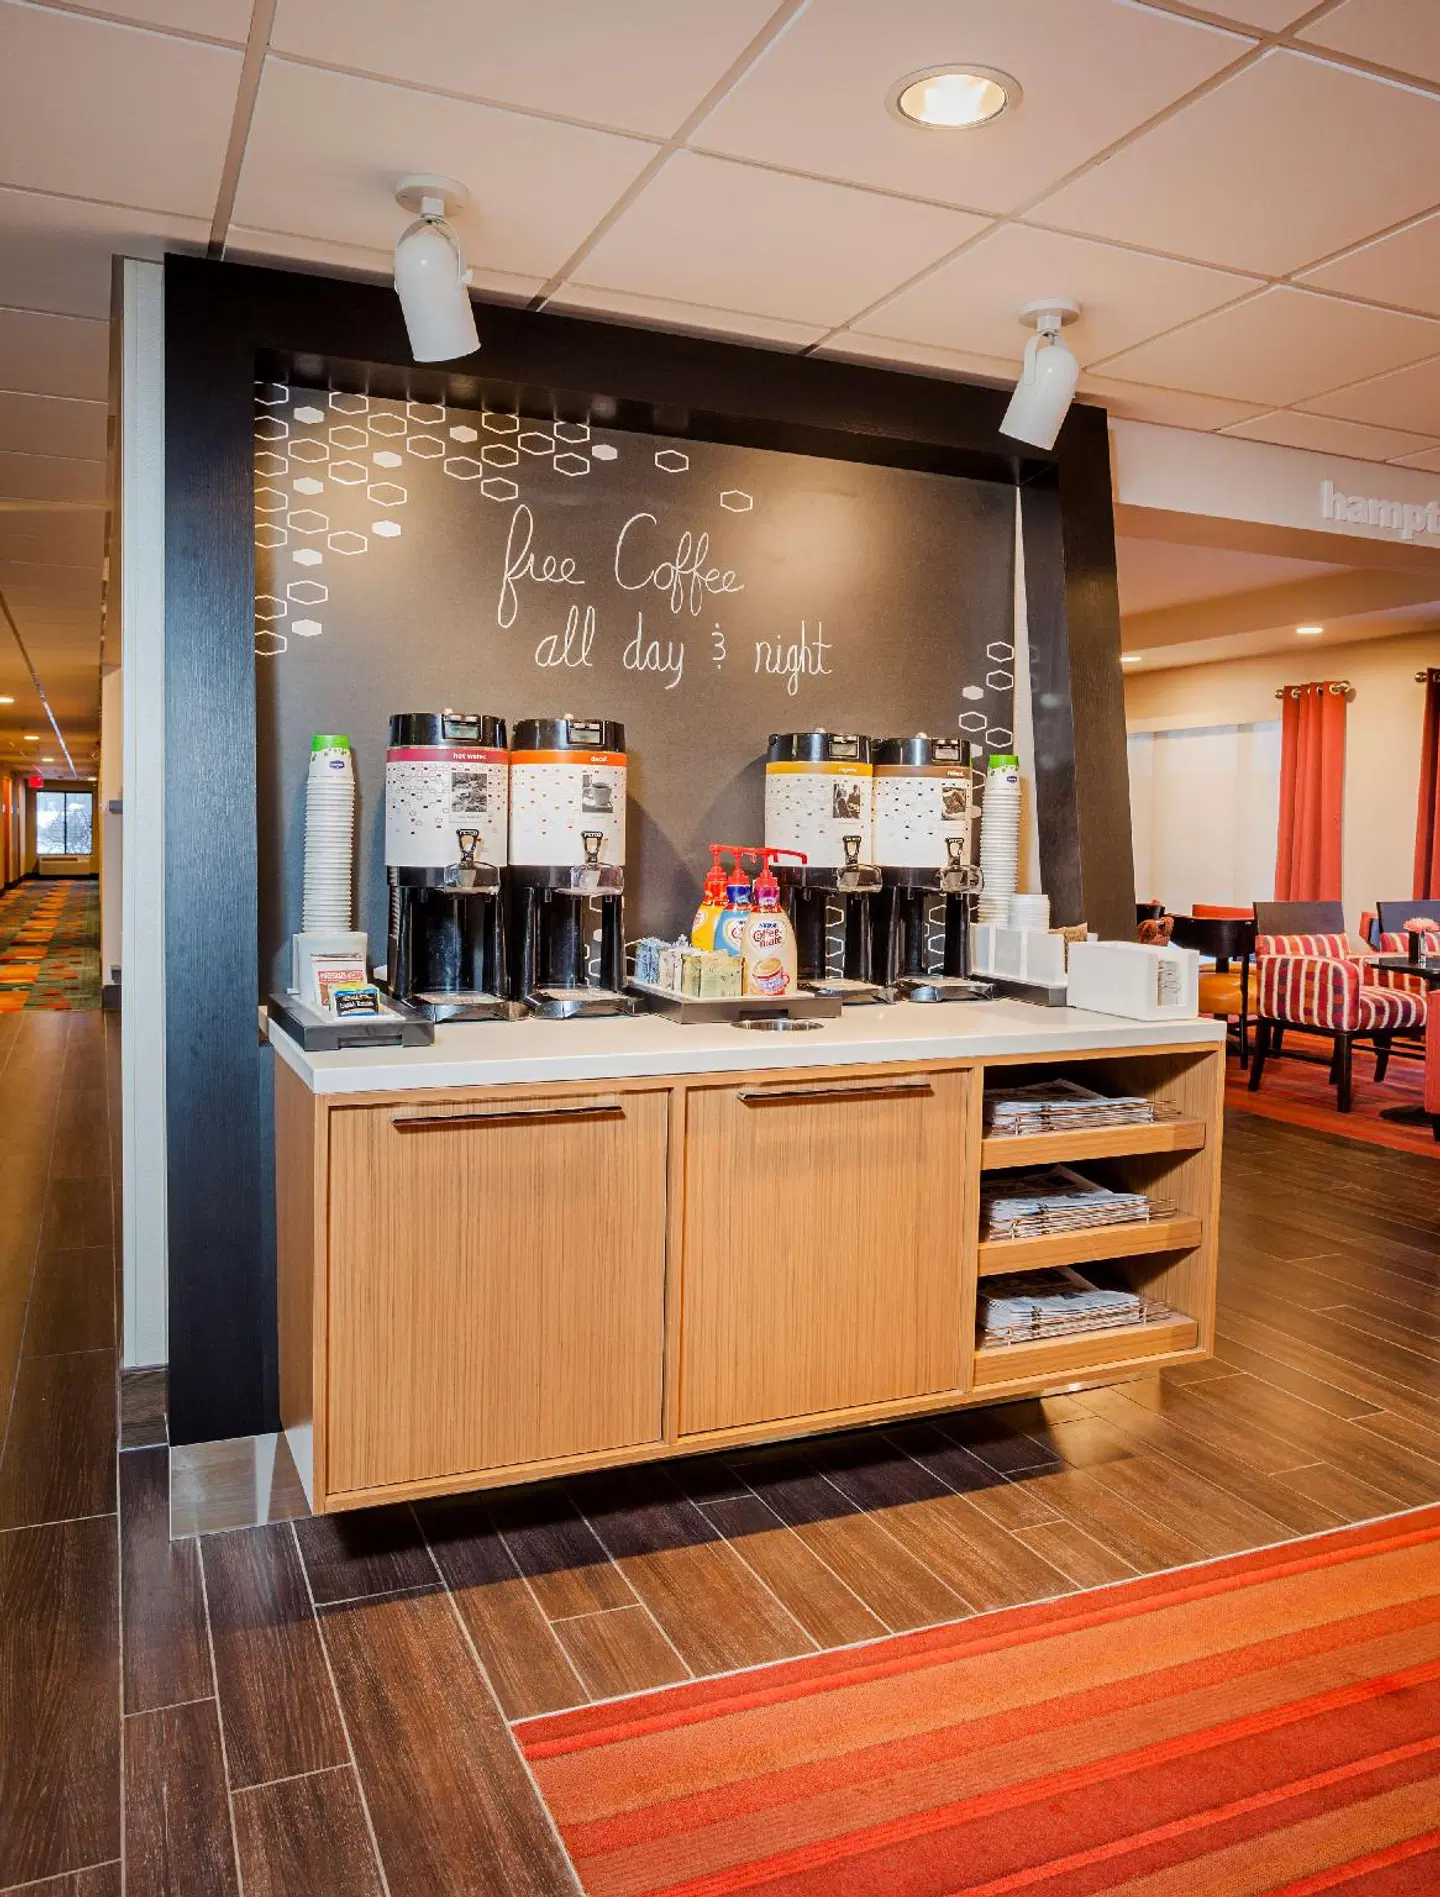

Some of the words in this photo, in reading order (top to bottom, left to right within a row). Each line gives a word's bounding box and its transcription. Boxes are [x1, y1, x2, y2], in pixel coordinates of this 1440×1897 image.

[497, 503, 585, 628] free
[614, 512, 745, 616] Coffee
[535, 604, 595, 668] all
[623, 611, 685, 690] day
[754, 619, 832, 695] night
